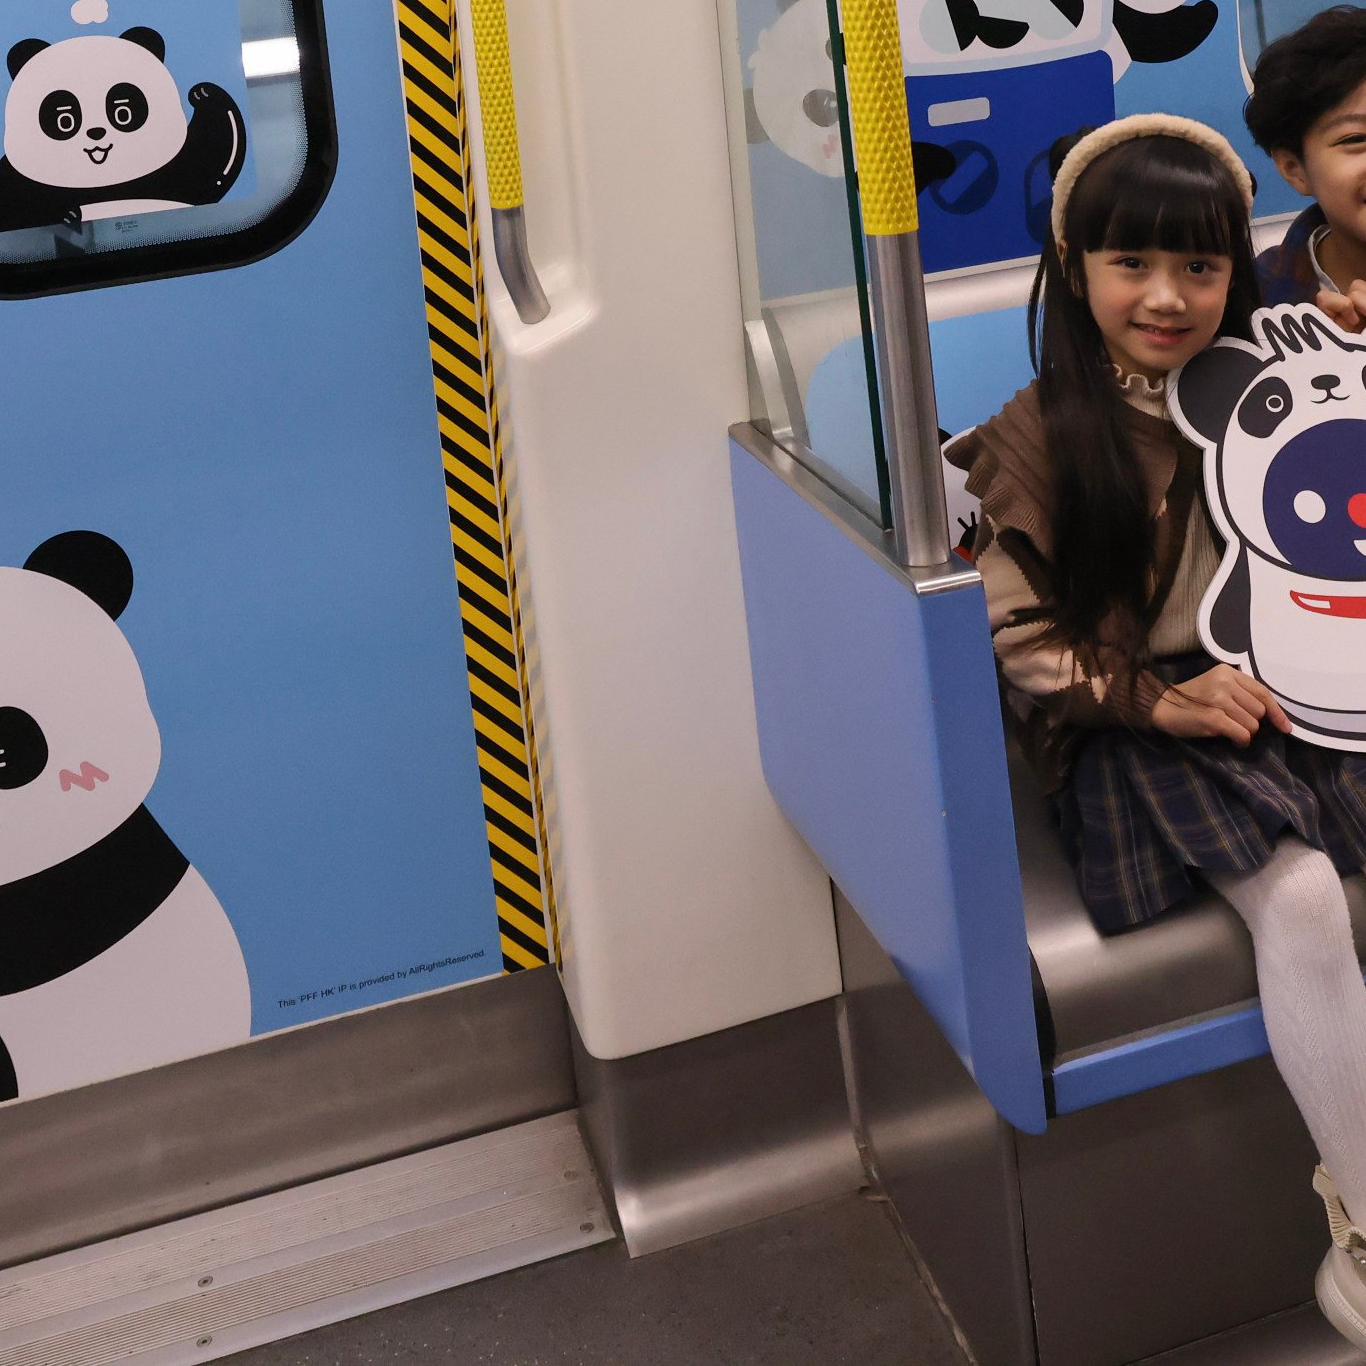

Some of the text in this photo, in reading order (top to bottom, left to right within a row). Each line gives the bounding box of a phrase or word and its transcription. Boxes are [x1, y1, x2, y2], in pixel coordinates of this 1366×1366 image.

[278, 996, 296, 1009] This
[338, 984, 347, 994] IP
[349, 982, 357, 990] is
[359, 972, 395, 990] provided
[397, 970, 408, 980] by
